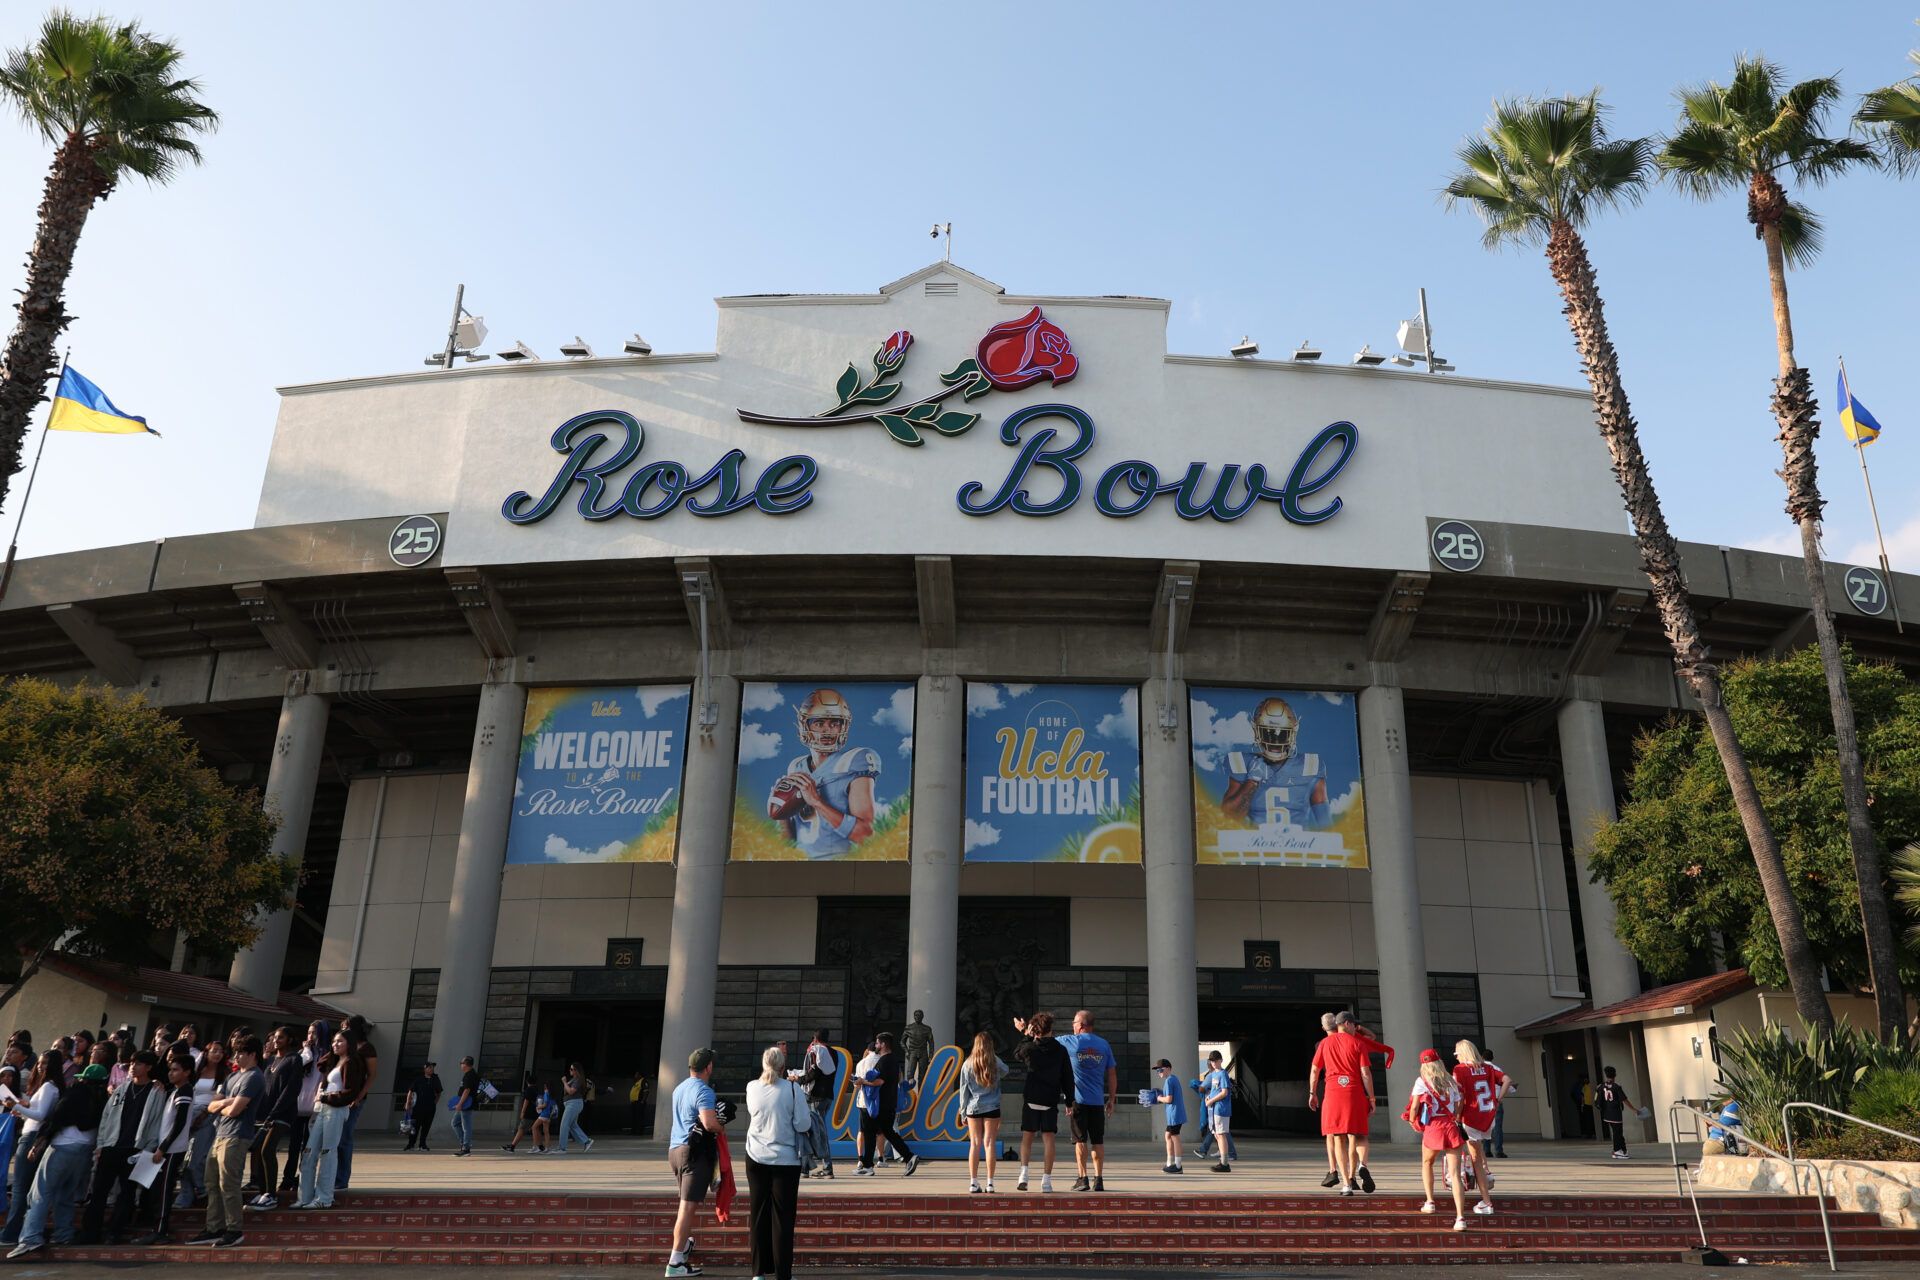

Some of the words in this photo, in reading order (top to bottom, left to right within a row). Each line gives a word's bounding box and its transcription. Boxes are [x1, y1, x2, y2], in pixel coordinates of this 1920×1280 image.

[501, 408, 819, 526] Rose
[955, 402, 1360, 526] Bowl
[393, 526, 436, 555] 25
[1437, 532, 1478, 560] 26
[1849, 576, 1880, 604] 27
[1039, 716, 1068, 727] HOME
[1047, 730, 1060, 741] OF
[534, 730, 673, 770] WELCOME
[565, 772, 577, 783] TO
[625, 770, 642, 781] THE
[518, 788, 590, 817] Rose
[588, 787, 674, 816] Bowl
[981, 775, 1125, 816] FOOTBALL
[1265, 786, 1291, 824] 6
[1247, 836, 1280, 849] Rose
[1279, 837, 1316, 849] Bowl
[615, 952, 632, 965] 25
[1255, 955, 1271, 968] 26
[1475, 1081, 1494, 1111] 2
